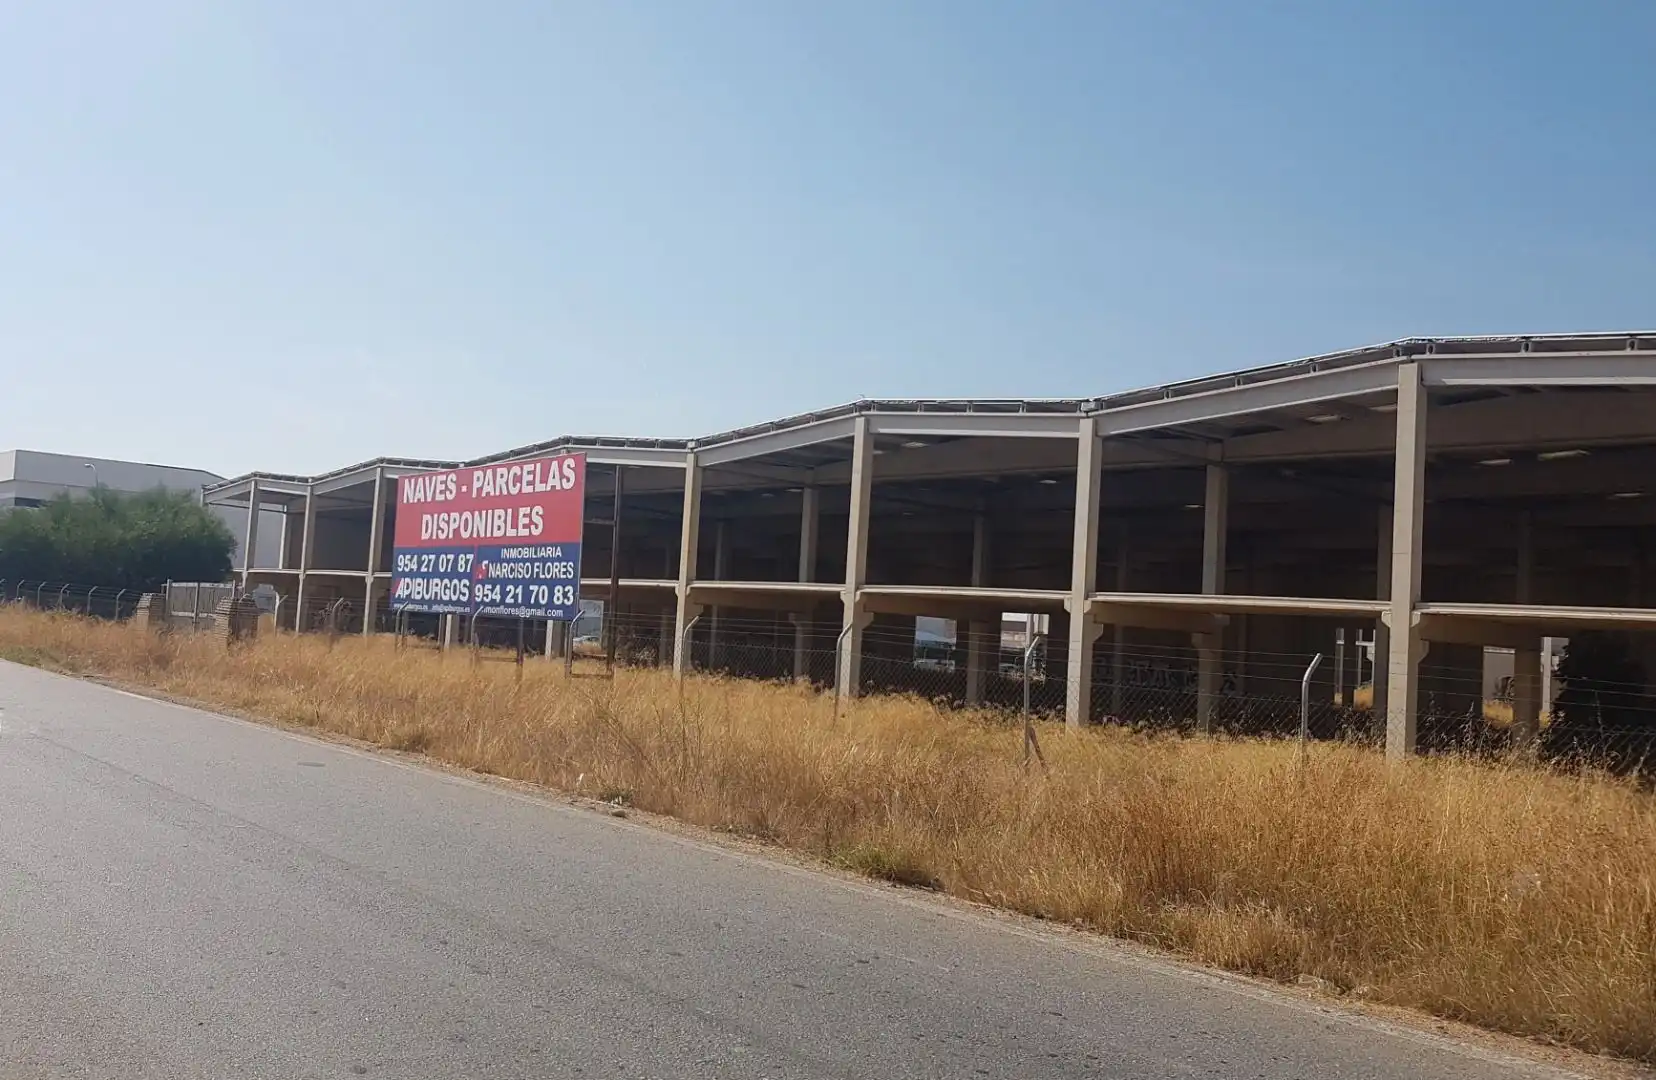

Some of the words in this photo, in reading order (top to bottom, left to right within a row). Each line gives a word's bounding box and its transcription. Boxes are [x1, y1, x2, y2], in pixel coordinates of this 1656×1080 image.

[403, 472, 457, 504] NAVES
[472, 458, 576, 498] PARCELAS
[421, 505, 543, 540] DISPONIBLES
[397, 554, 418, 572] 954
[420, 554, 436, 572] 27
[439, 554, 454, 572] 07
[458, 554, 474, 572] 87
[501, 546, 562, 559] INMOBILIARIA
[488, 562, 532, 579] NARCISO
[533, 562, 574, 579] FLORES
[395, 577, 470, 602] APIBURGOS
[475, 584, 501, 603] 954
[505, 584, 522, 604] 21
[529, 585, 548, 605] 70
[553, 585, 574, 606] 83
